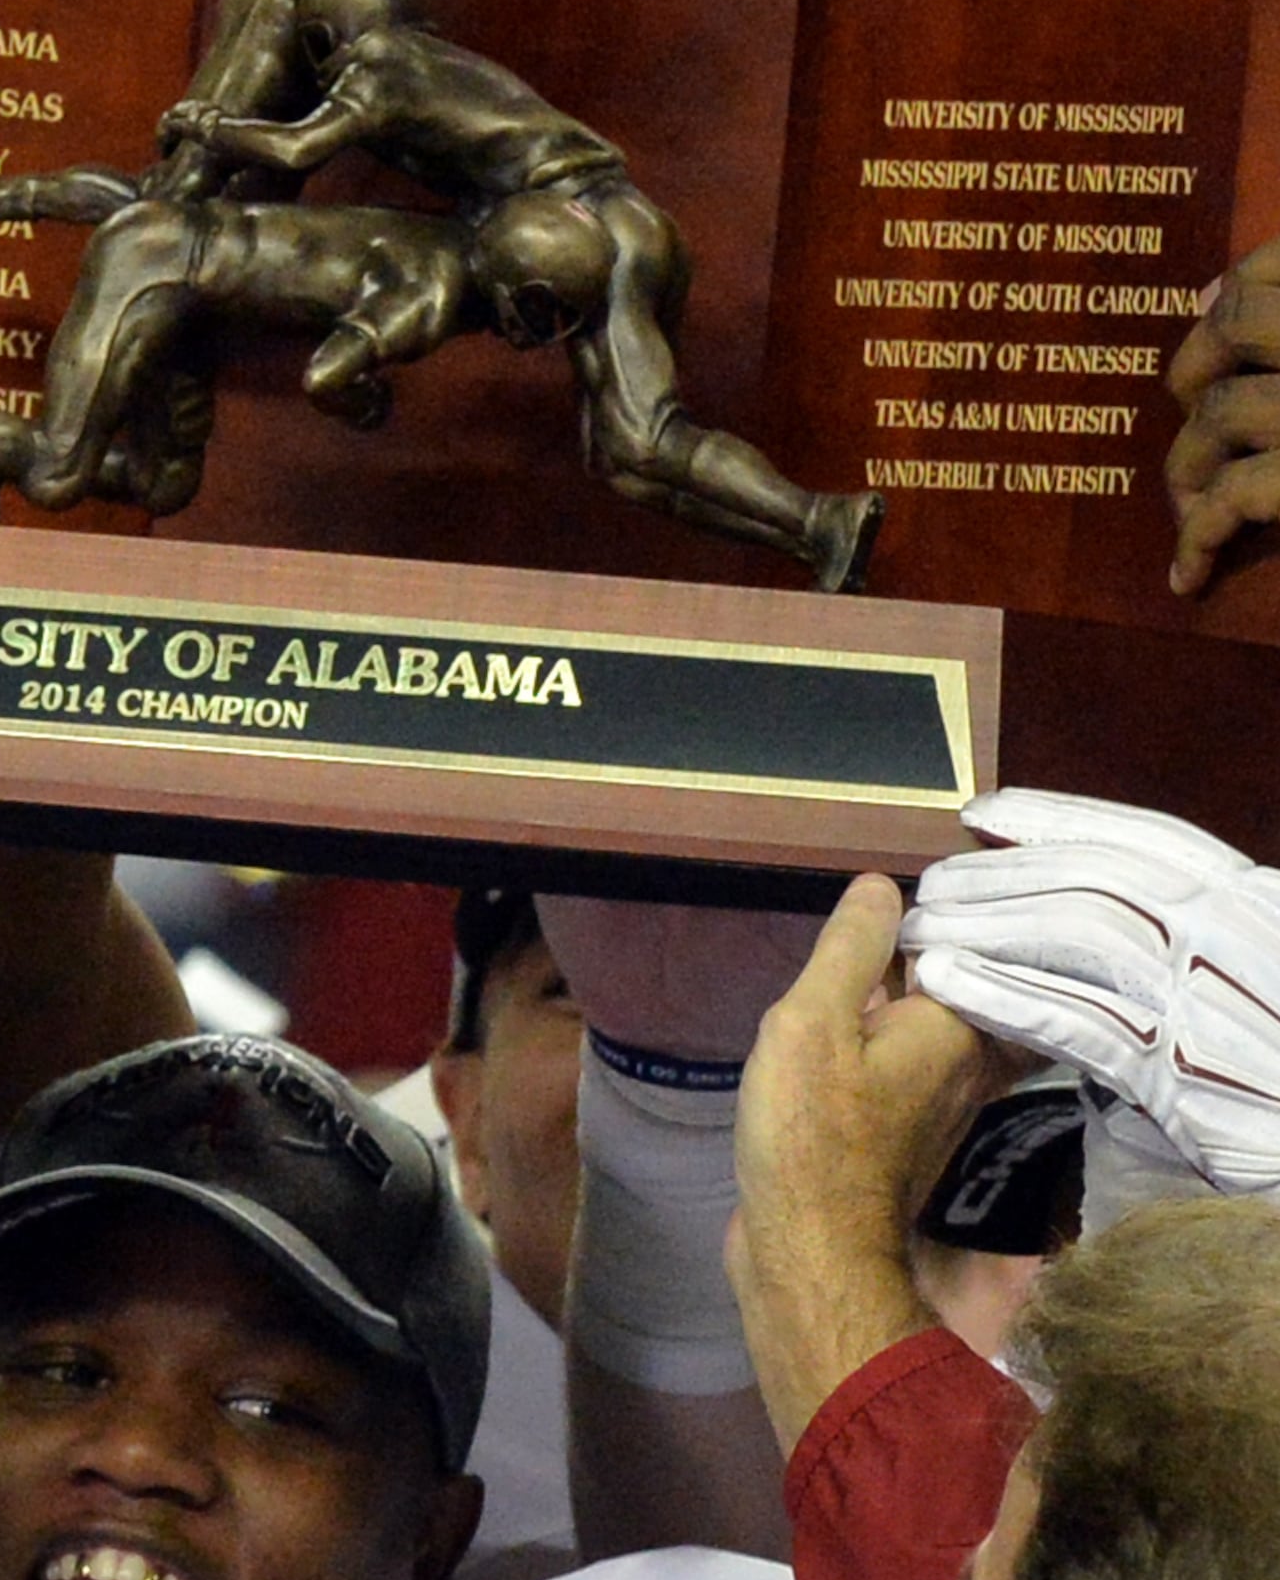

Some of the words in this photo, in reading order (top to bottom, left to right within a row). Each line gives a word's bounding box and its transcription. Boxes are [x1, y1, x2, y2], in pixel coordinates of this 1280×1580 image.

[883, 99, 1015, 130] UNIVERSITY
[1019, 103, 1050, 131] OF
[1054, 104, 1185, 134] MISSISSIPPI
[860, 159, 989, 190] MISSISSIPPI
[993, 162, 1061, 192] STATE
[1065, 165, 1197, 195] UNIVERSITY
[882, 219, 1013, 251] UNIVERSITY
[1017, 223, 1049, 252] OF
[1052, 224, 1162, 255] MISSOURI
[834, 278, 964, 310] UNIVERSITY
[968, 281, 1000, 311] OF
[1004, 283, 1081, 313] SOUTH
[1086, 285, 1204, 317] CAROLINA
[863, 339, 994, 371] UNIVERSITY
[997, 343, 1028, 372] OF
[1033, 344, 1161, 376] TENNESSEE
[874, 398, 945, 429] TEXAS
[948, 401, 1001, 431] A&M
[1006, 404, 1138, 436] UNIVERSITY
[865, 458, 999, 491] VANDERBILT
[1004, 462, 1136, 495] UNIVERSITY
[163, 629, 256, 683] OF
[267, 637, 583, 708] ALABAMA
[19, 680, 106, 716] 2014
[117, 686, 308, 731] CHAMPION
